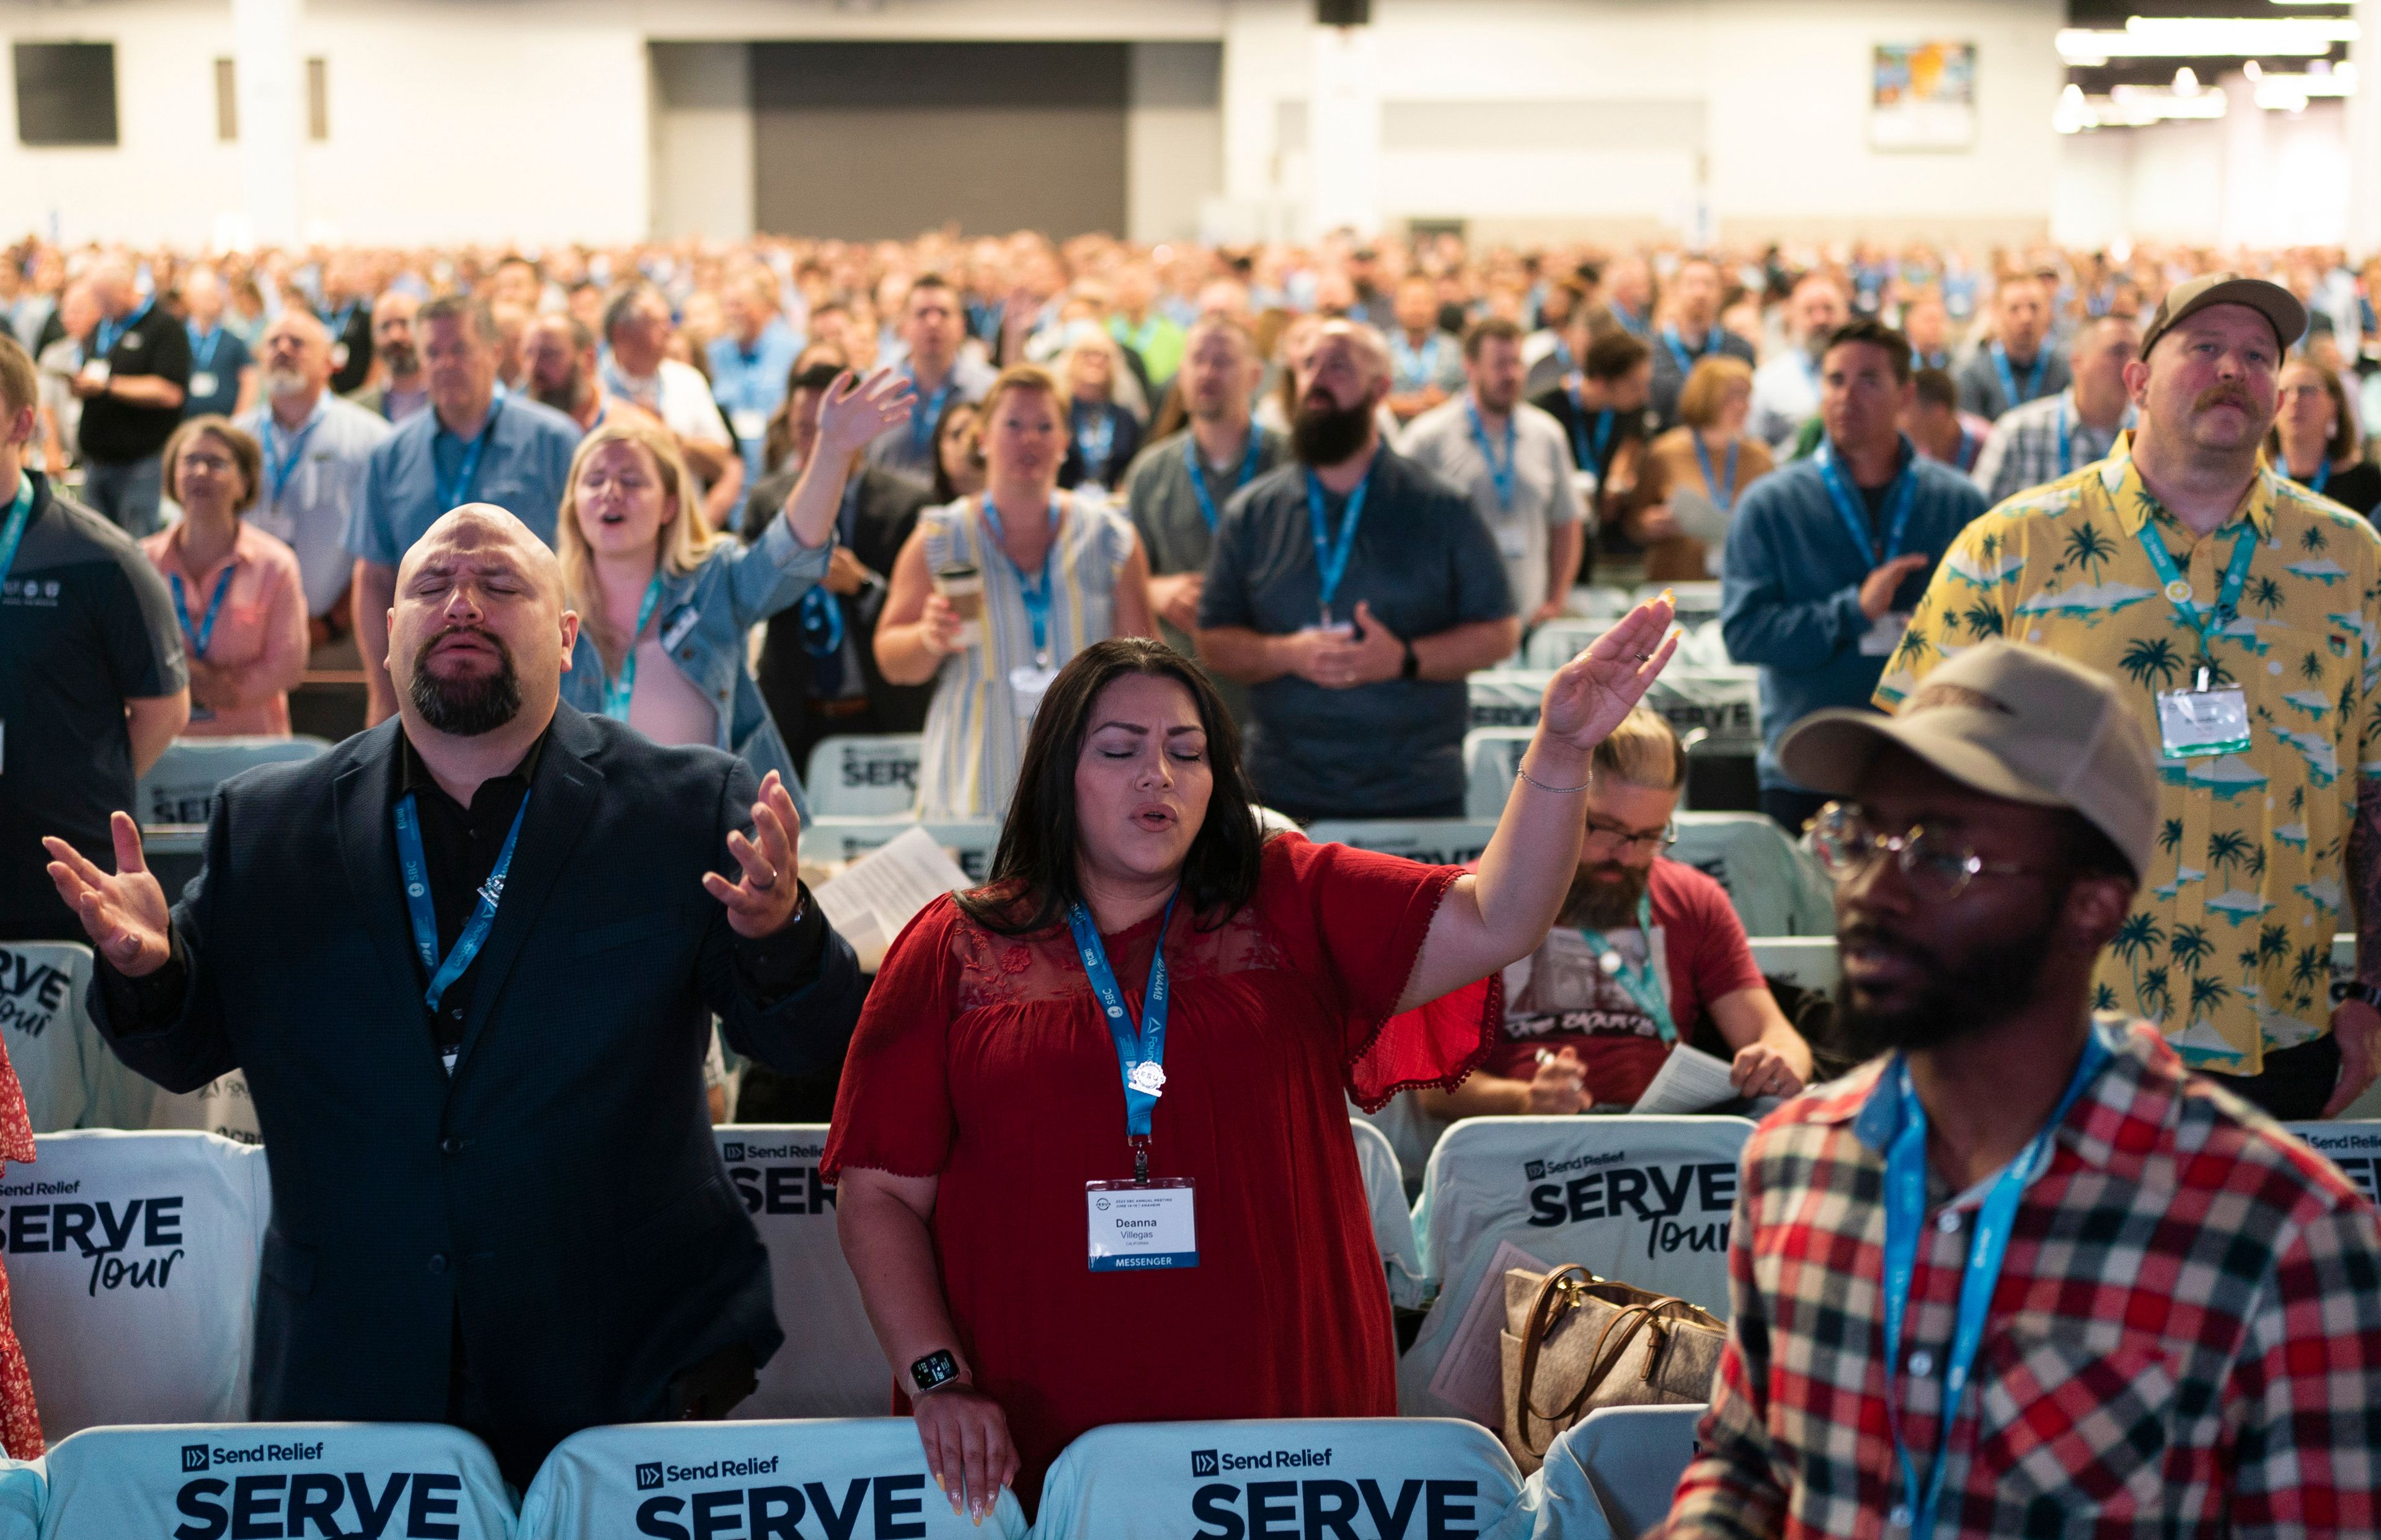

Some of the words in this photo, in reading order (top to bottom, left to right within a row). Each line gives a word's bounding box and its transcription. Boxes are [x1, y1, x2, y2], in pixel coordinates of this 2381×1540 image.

[407, 860, 419, 882] SBC
[1084, 949, 1096, 960] CBU
[1153, 968, 1164, 1001] NAMB
[1102, 988, 1116, 1005] SBC
[748, 1145, 787, 1158] Send
[1547, 1155, 1582, 1174] Send
[1582, 1150, 1625, 1167] Relief
[36, 1180, 80, 1195] Relief
[1527, 1162, 1736, 1228] SERVE
[1115, 1219, 1157, 1228] Deanna
[1120, 1231, 1153, 1240] Villegas
[82, 1248, 185, 1297] Tour
[1115, 1257, 1172, 1267] MESSENGER
[212, 1445, 264, 1464] Send
[267, 1441, 324, 1461] Relief
[1222, 1451, 1272, 1471] Send
[1275, 1448, 1332, 1467] Relief
[667, 1462, 719, 1482] Send
[722, 1455, 779, 1477] Relief
[174, 1472, 462, 1540] SERVE
[636, 1473, 927, 1540] SERVE
[1191, 1478, 1480, 1540] SERVE
